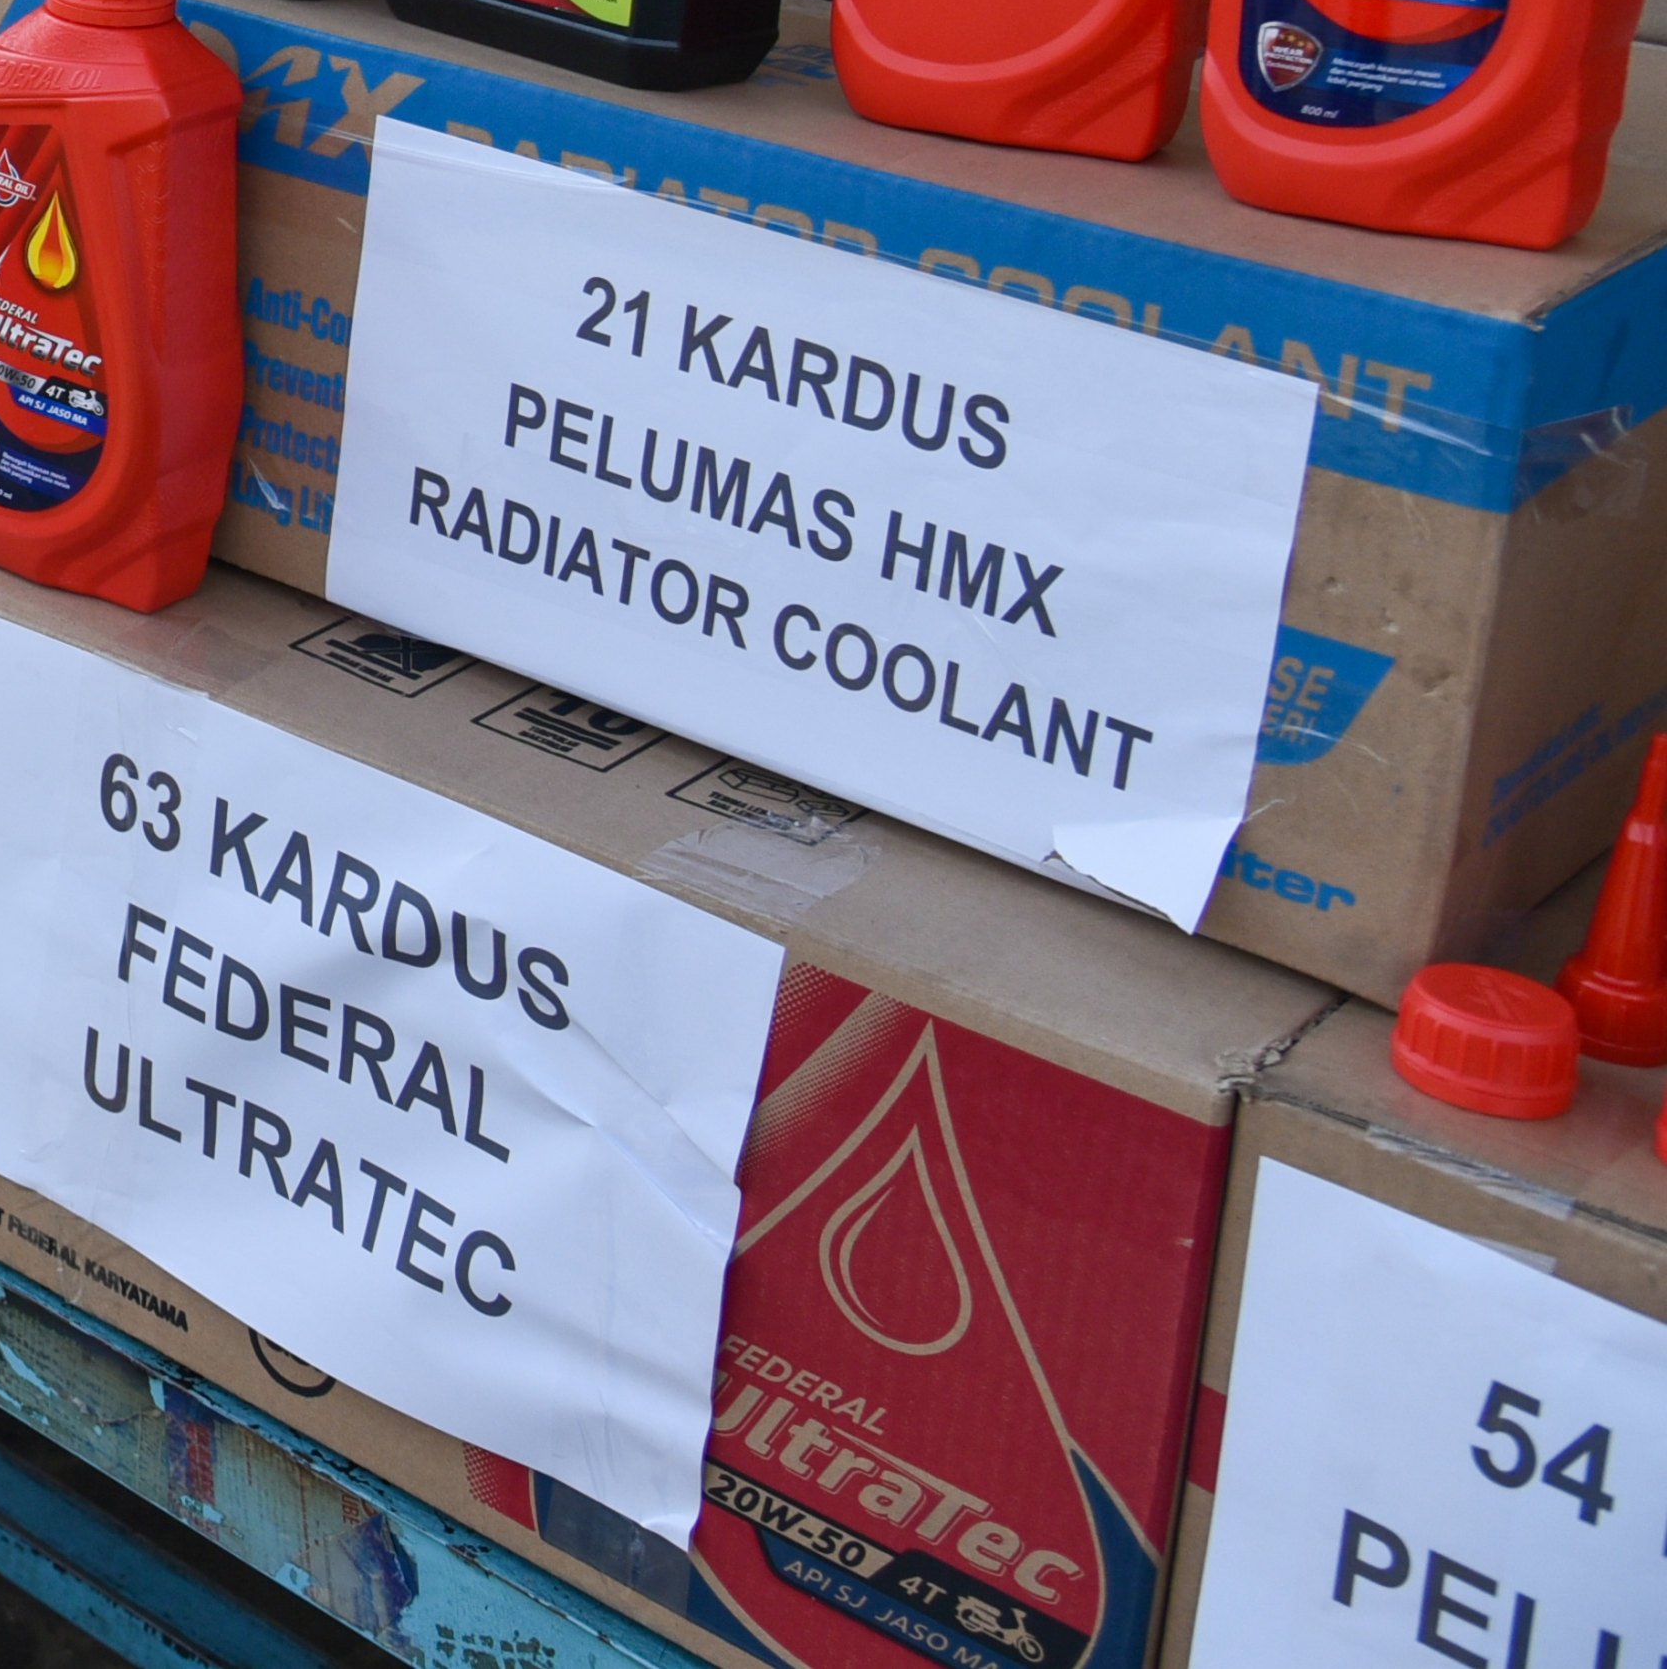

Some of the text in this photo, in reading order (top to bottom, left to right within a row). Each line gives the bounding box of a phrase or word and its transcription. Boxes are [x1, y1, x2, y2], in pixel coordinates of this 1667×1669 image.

[68, 68, 103, 90] OIL
[1272, 46, 1304, 57] WEAR
[1300, 104, 1340, 118] 800 ml
[14, 181, 30, 196] OIL
[18, 394, 88, 427] API SJ JASO MA
[45, 385, 66, 400] 4T
[575, 275, 1012, 471] 21 KARDUS
[504, 381, 1065, 642] PELUMAS HMX
[407, 466, 1156, 794] RADIATOR COOLANT
[99, 752, 571, 1032] 63 KARDUS
[1220, 842, 1356, 913] iter
[118, 903, 510, 1163] FEDERAL
[83, 1026, 517, 1320] ULTRATEC
[7, 1214, 80, 1270] FEDERAL
[84, 1258, 188, 1332] KARYATAMA
[719, 1334, 890, 1437] FEDERAL
[1470, 1380, 1614, 1527] 54
[708, 1472, 947, 1606] 20W-50 4T
[783, 1559, 1000, 1669] API SJ JASO MA
